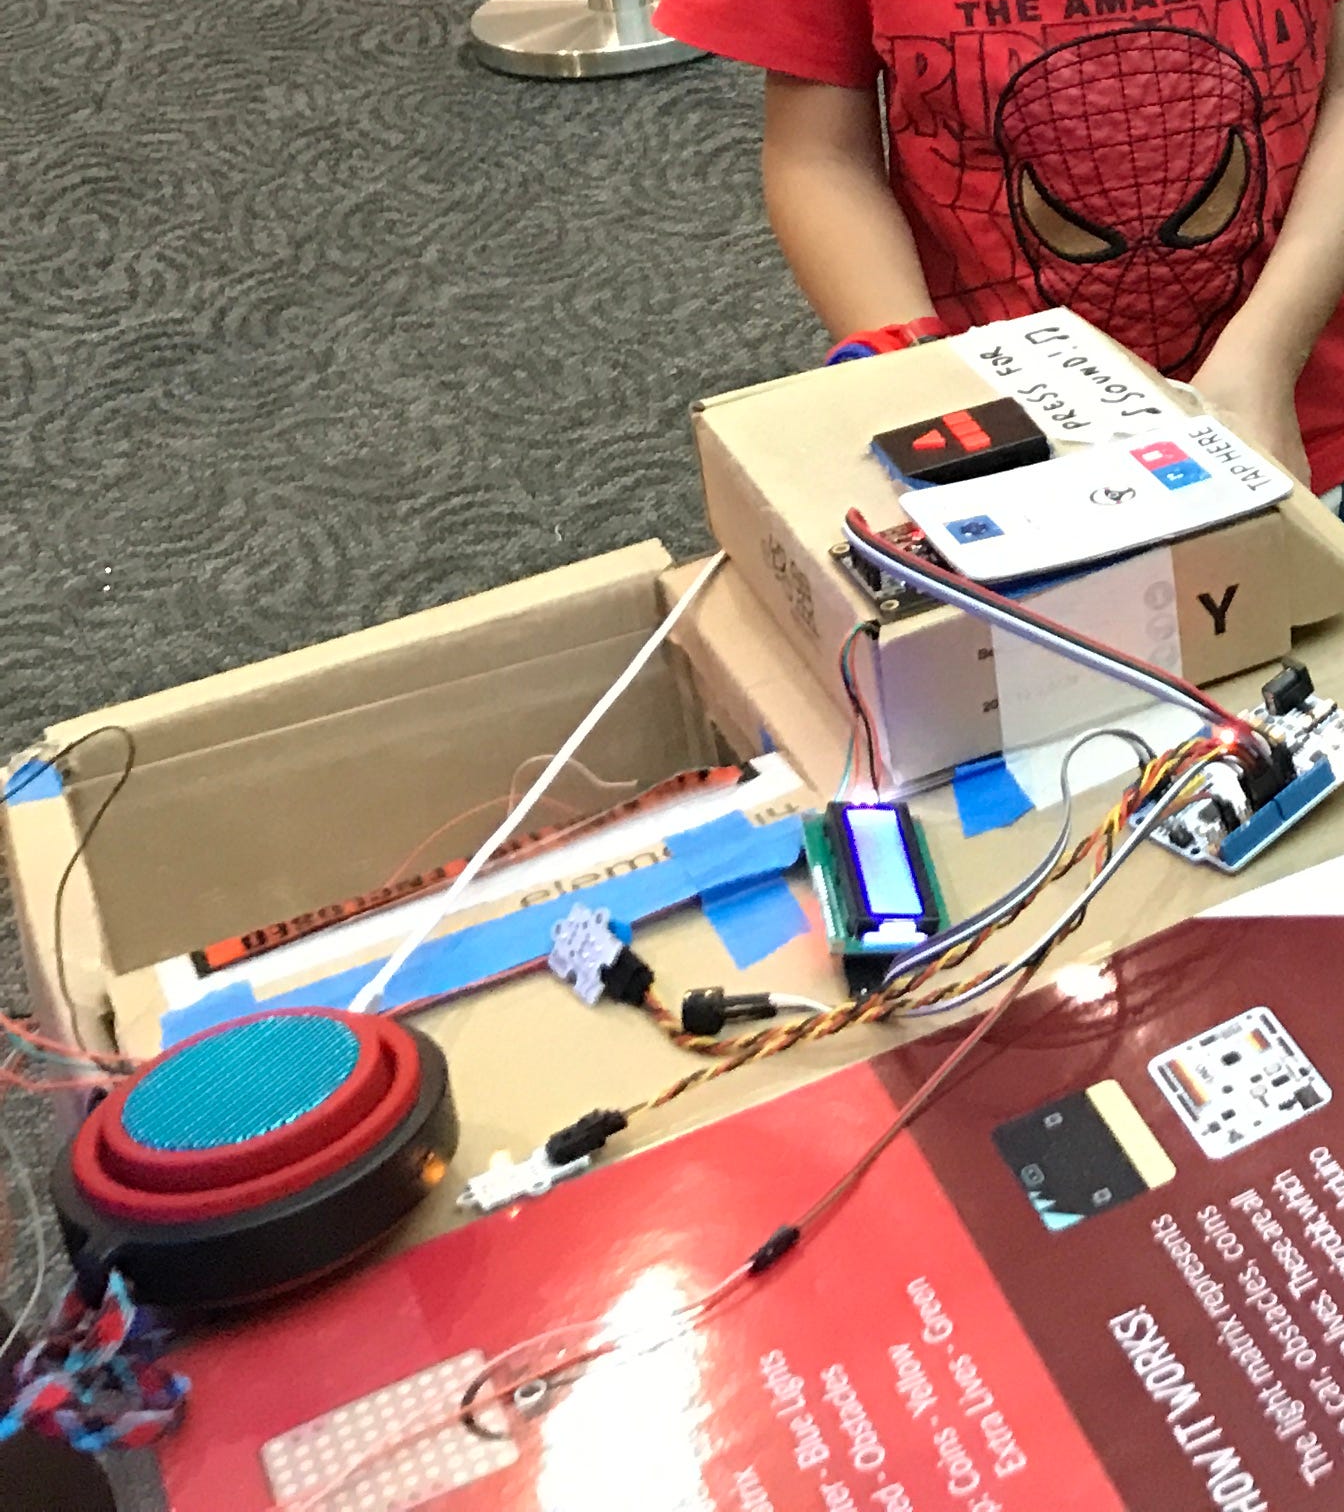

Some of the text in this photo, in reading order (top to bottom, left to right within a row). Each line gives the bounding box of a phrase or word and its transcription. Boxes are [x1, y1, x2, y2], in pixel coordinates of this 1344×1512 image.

[980, 346, 1091, 429] PRESS FOR
[1188, 426, 1272, 491] TAP HERE
[1230, 1188, 1264, 1215] all
[1251, 1208, 1284, 1242] are
[1273, 1169, 1319, 1220] which
[1197, 1205, 1244, 1262] coins
[1272, 1237, 1318, 1301] These
[906, 1276, 953, 1344] Green
[1239, 1259, 1317, 1370] obstacles,
[760, 1349, 805, 1418] Lights
[888, 1343, 938, 1419] Yellow
[1151, 1213, 1334, 1487] The light matrix represents
[820, 1364, 886, 1472] Obstacles
[949, 1354, 994, 1416] Lives
[1108, 1304, 1268, 1512] HOW IT WORKS!
[790, 1412, 829, 1470] Blue
[934, 1427, 981, 1496] Coins
[980, 1411, 1027, 1478] Extra
